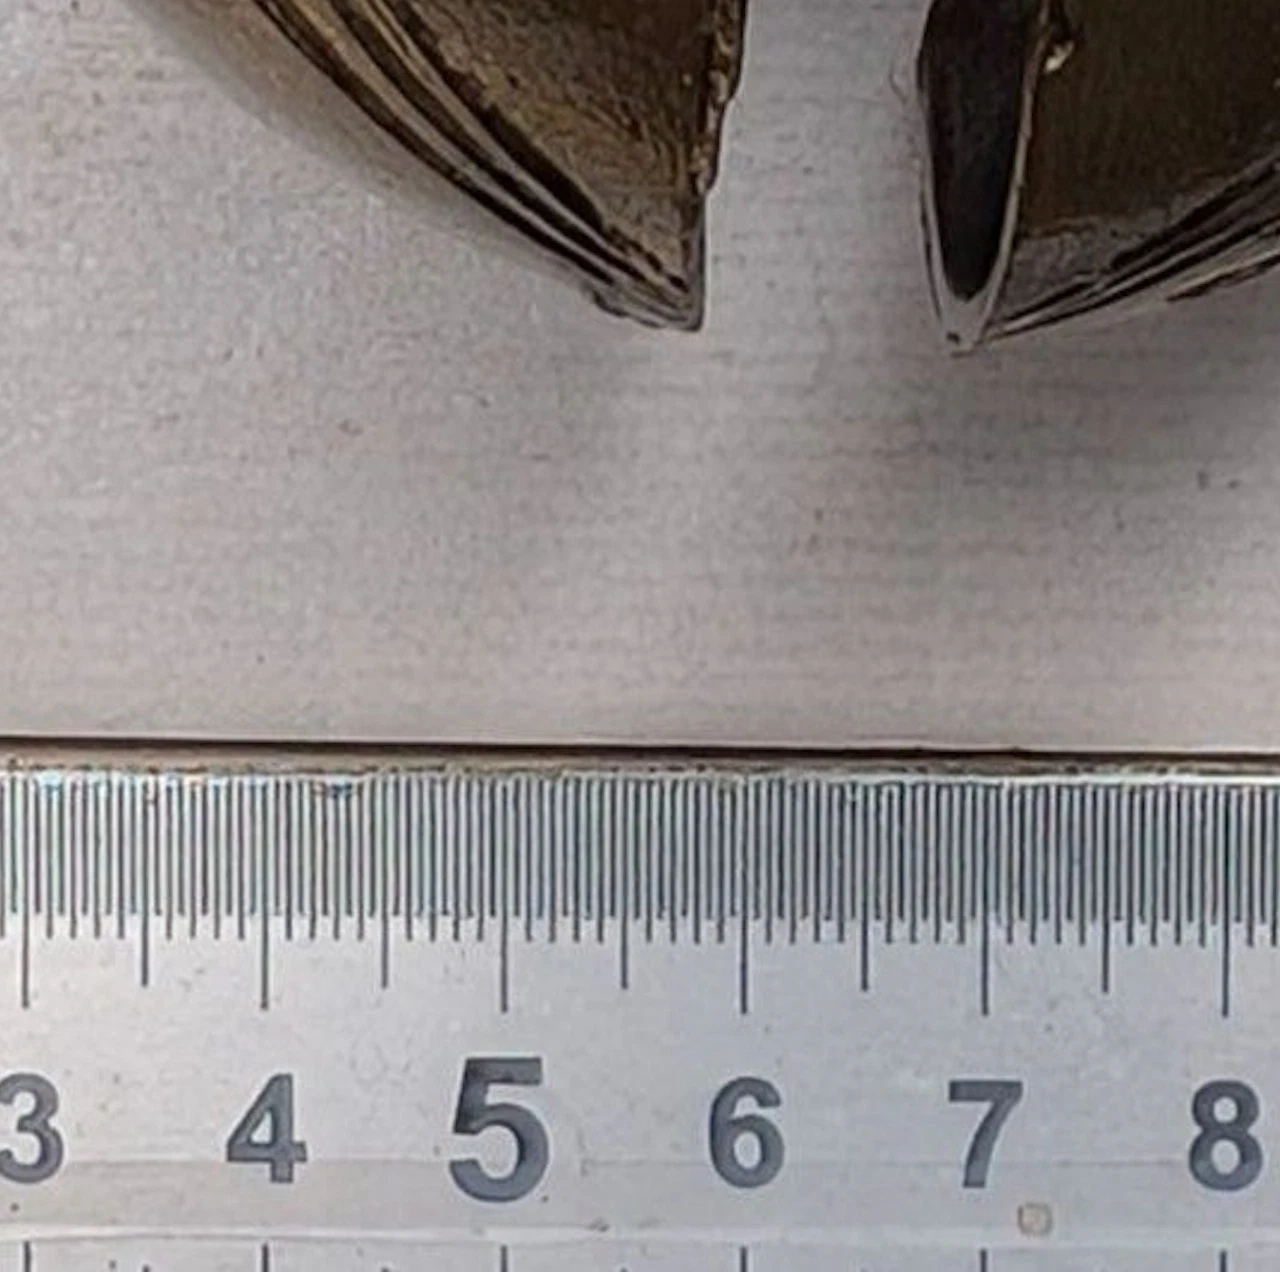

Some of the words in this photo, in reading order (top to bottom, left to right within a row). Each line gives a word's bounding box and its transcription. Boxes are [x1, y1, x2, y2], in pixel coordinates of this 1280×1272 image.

[226, 1074, 307, 1184] 4
[449, 1057, 548, 1203] 5
[709, 1077, 784, 1188] 6
[948, 1080, 1022, 1188] 7
[1189, 1081, 1262, 1191] 8
